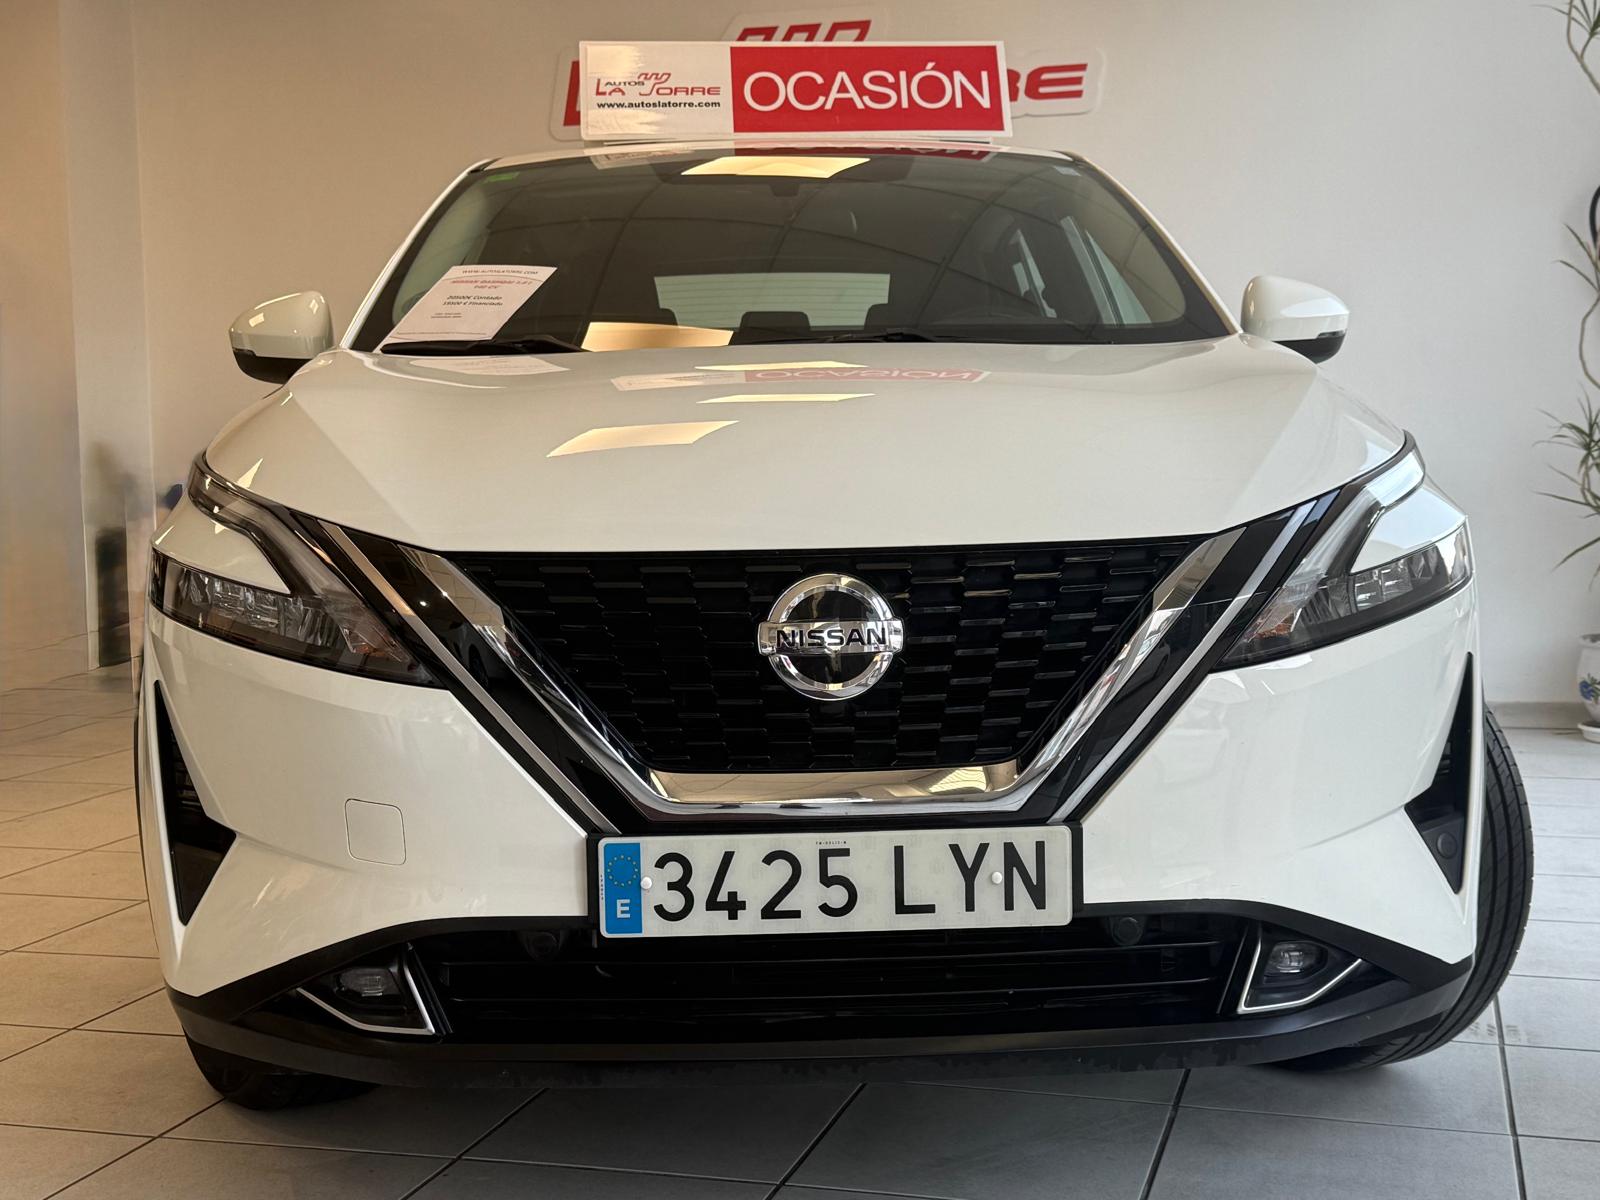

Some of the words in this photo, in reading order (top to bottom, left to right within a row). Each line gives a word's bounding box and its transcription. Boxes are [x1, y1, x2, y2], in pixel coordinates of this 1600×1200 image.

[595, 78, 626, 97] LA
[743, 62, 992, 111] OCASIÓN
[596, 100, 721, 109] www.autoslatorre.com
[776, 627, 887, 647] NISSAN
[652, 847, 859, 923] 3425
[893, 840, 1047, 915] LYN
[616, 898, 631, 919] E
